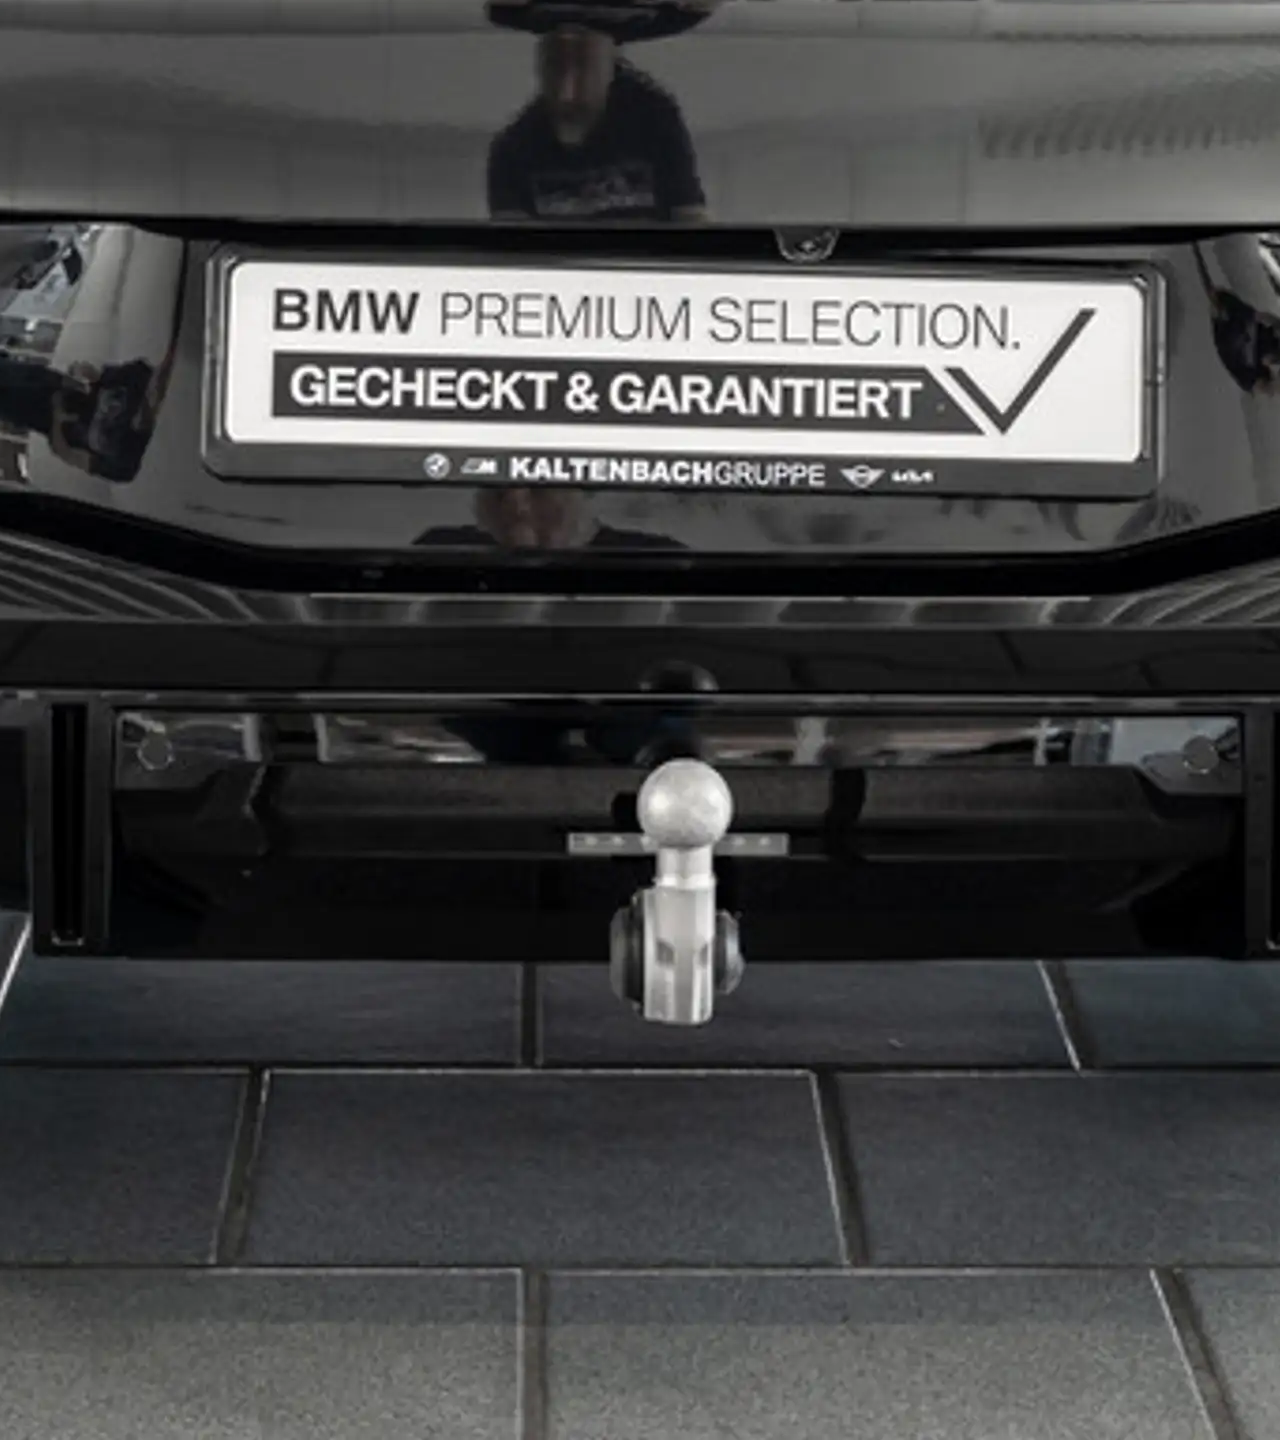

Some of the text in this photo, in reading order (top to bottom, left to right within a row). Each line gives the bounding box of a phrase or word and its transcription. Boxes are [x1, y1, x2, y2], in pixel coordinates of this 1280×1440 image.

[273, 287, 1022, 351] BMW PREMIUM SELECTION.
[289, 364, 924, 420] GECHECKT & GARANTIERT
[509, 456, 827, 487] KALTENBACHGRUPPE
